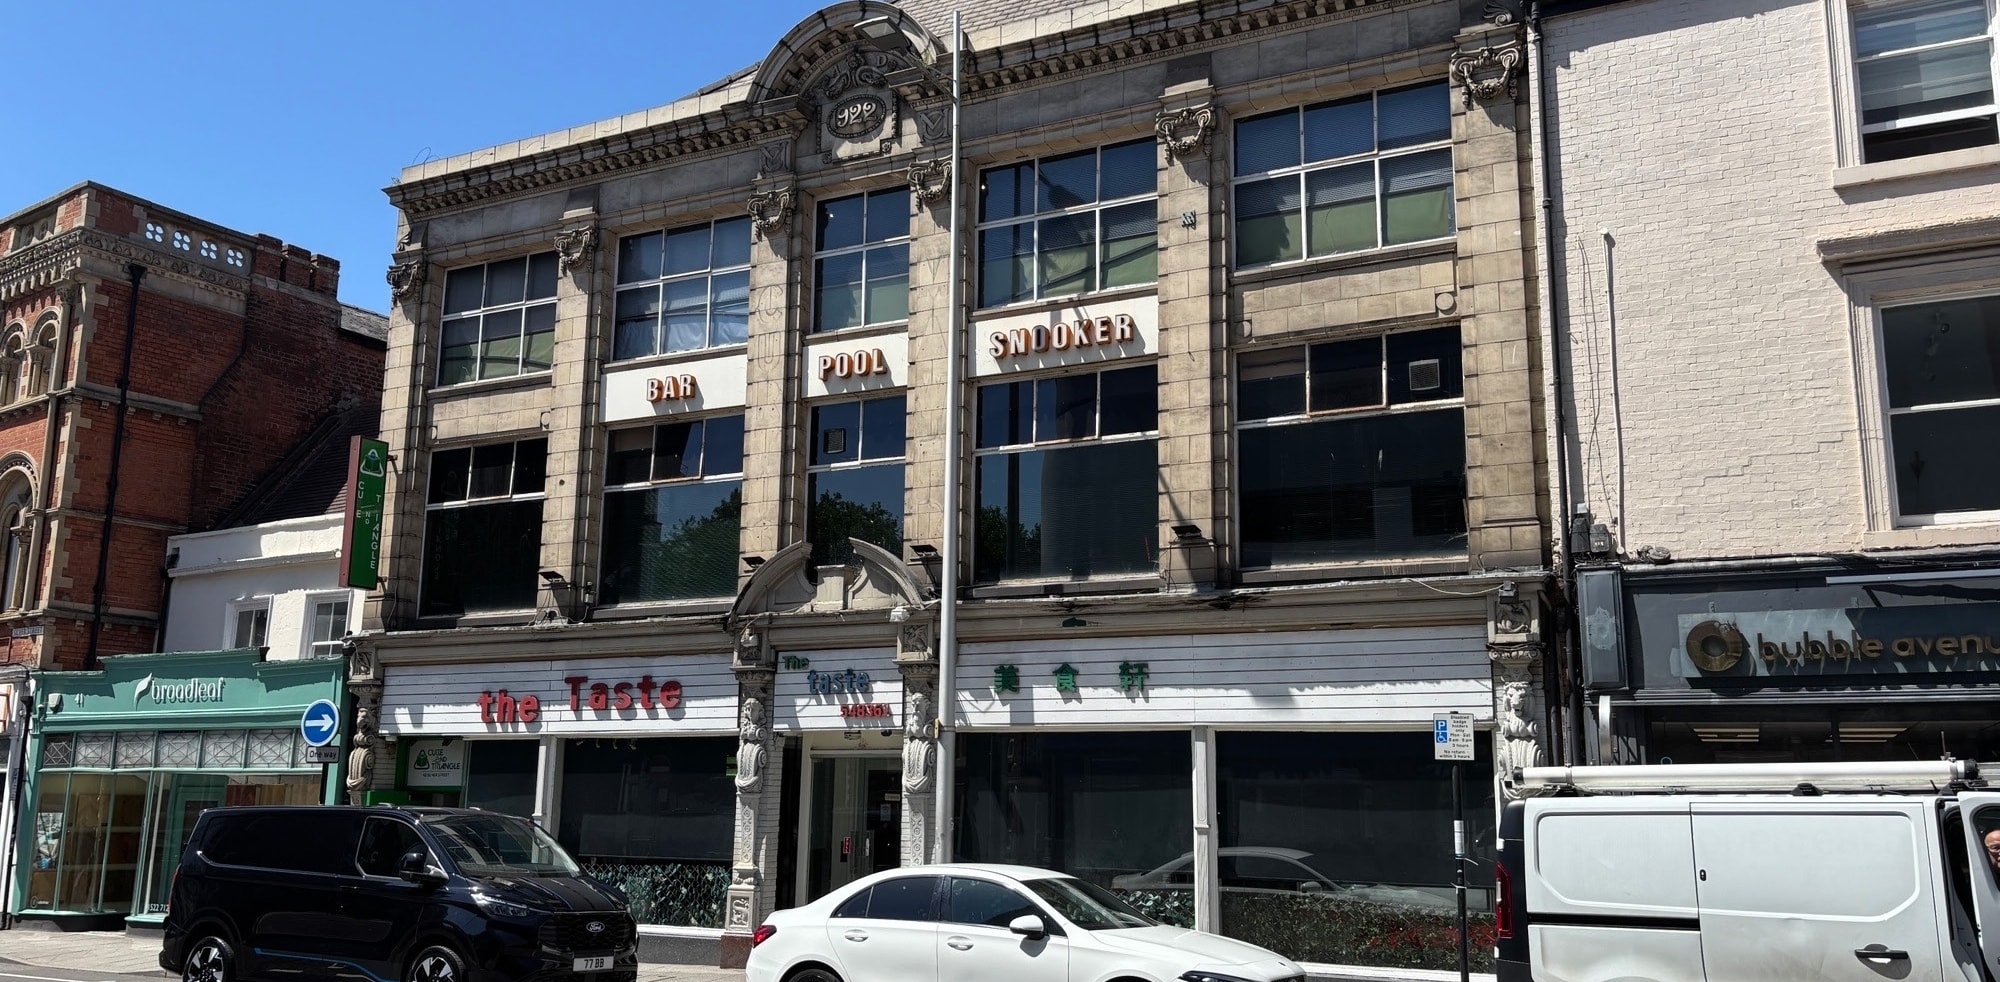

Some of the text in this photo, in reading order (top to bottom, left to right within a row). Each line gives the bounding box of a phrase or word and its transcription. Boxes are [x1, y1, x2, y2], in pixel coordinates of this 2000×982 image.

[989, 313, 1134, 359] SNOOKER
[818, 348, 887, 381] POOL
[646, 373, 697, 403] BAR
[1757, 630, 1883, 661] bubble
[782, 655, 809, 670] The
[151, 677, 224, 702] broadleaf
[807, 668, 870, 695] taste
[74, 693, 84, 707] 41
[477, 674, 683, 724] the Taste
[324, 752, 337, 760] way
[584, 959, 593, 969] 77
